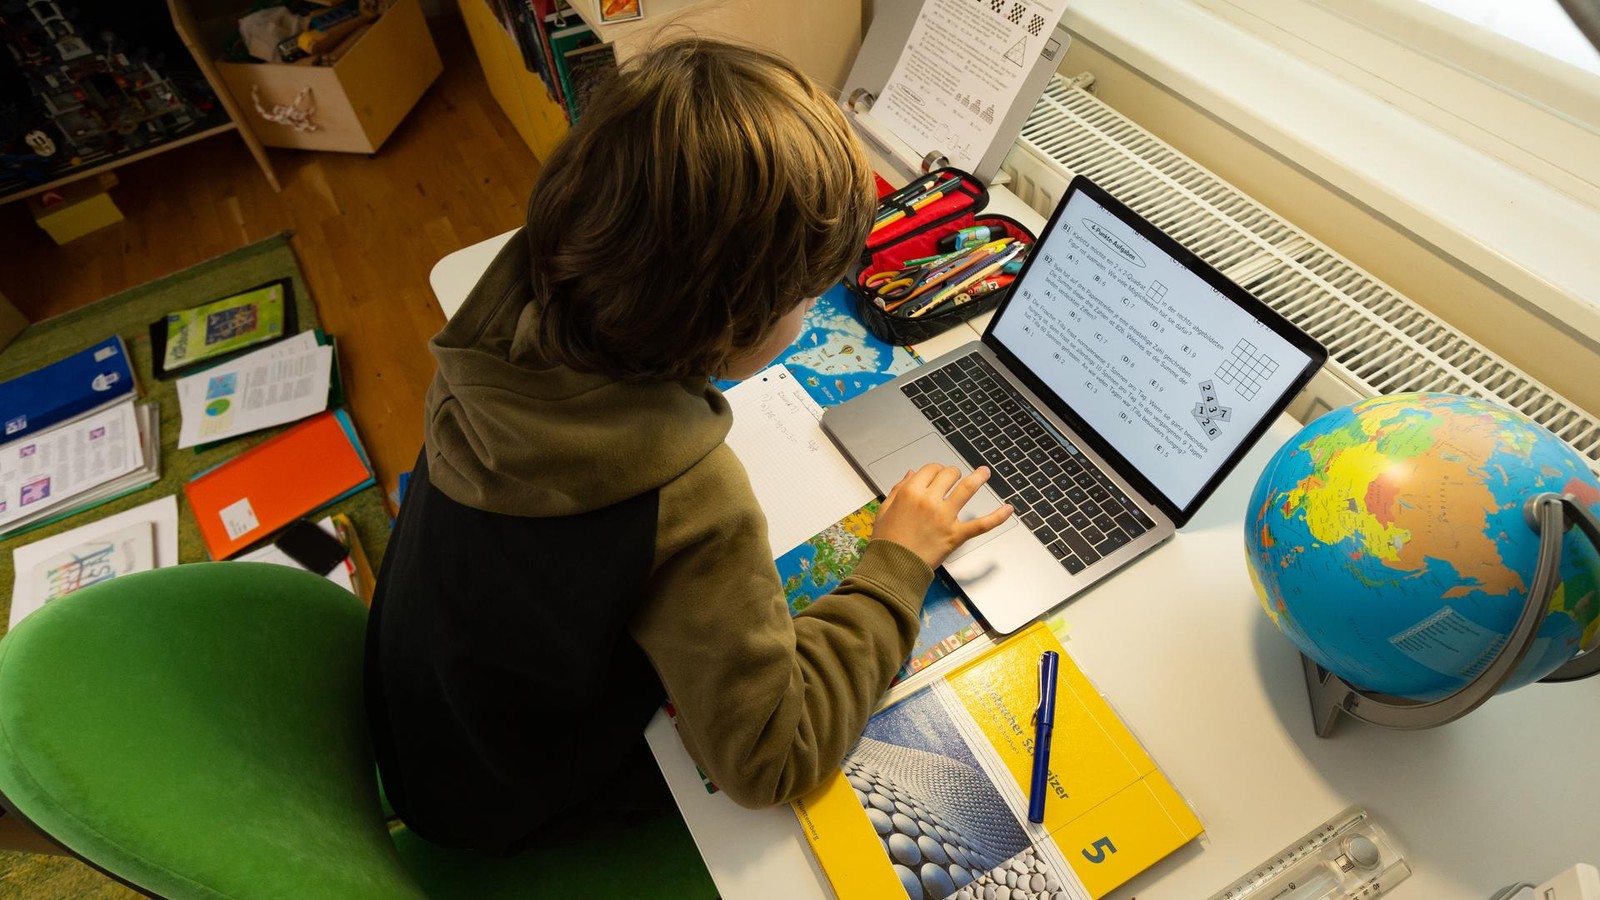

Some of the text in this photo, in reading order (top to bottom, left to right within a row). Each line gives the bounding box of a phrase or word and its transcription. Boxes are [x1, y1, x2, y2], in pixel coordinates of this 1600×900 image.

[1090, 224, 1136, 262] 4-Punkte-Aufgaben
[1066, 252, 1076, 263] (A)
[1062, 224, 1071, 232] B1
[1167, 305, 1177, 314] der
[1176, 311, 1193, 327] rechts
[1092, 274, 1103, 285] (B)
[1023, 291, 1032, 300] B3
[1044, 289, 1053, 299] (A)
[1044, 255, 1052, 264] B2
[1152, 344, 1165, 356] Zahl
[1120, 296, 1131, 307] (C)
[1068, 310, 1078, 320] (B)
[1022, 325, 1031, 335] (A)
[1149, 319, 1161, 331] (D)
[1094, 331, 1104, 342] (C)
[1180, 344, 1192, 356] (E)
[1052, 352, 1062, 362] (B)
[1120, 354, 1131, 365] (D)
[1084, 380, 1094, 391] (C)
[1148, 378, 1160, 390] (E)
[1178, 376, 1188, 386] der
[1118, 410, 1129, 422] (D)
[1154, 443, 1165, 455] (E)
[1186, 444, 1204, 461] Tagen
[1022, 736, 1069, 800] Sceizer
[1082, 836, 1117, 864] 5
